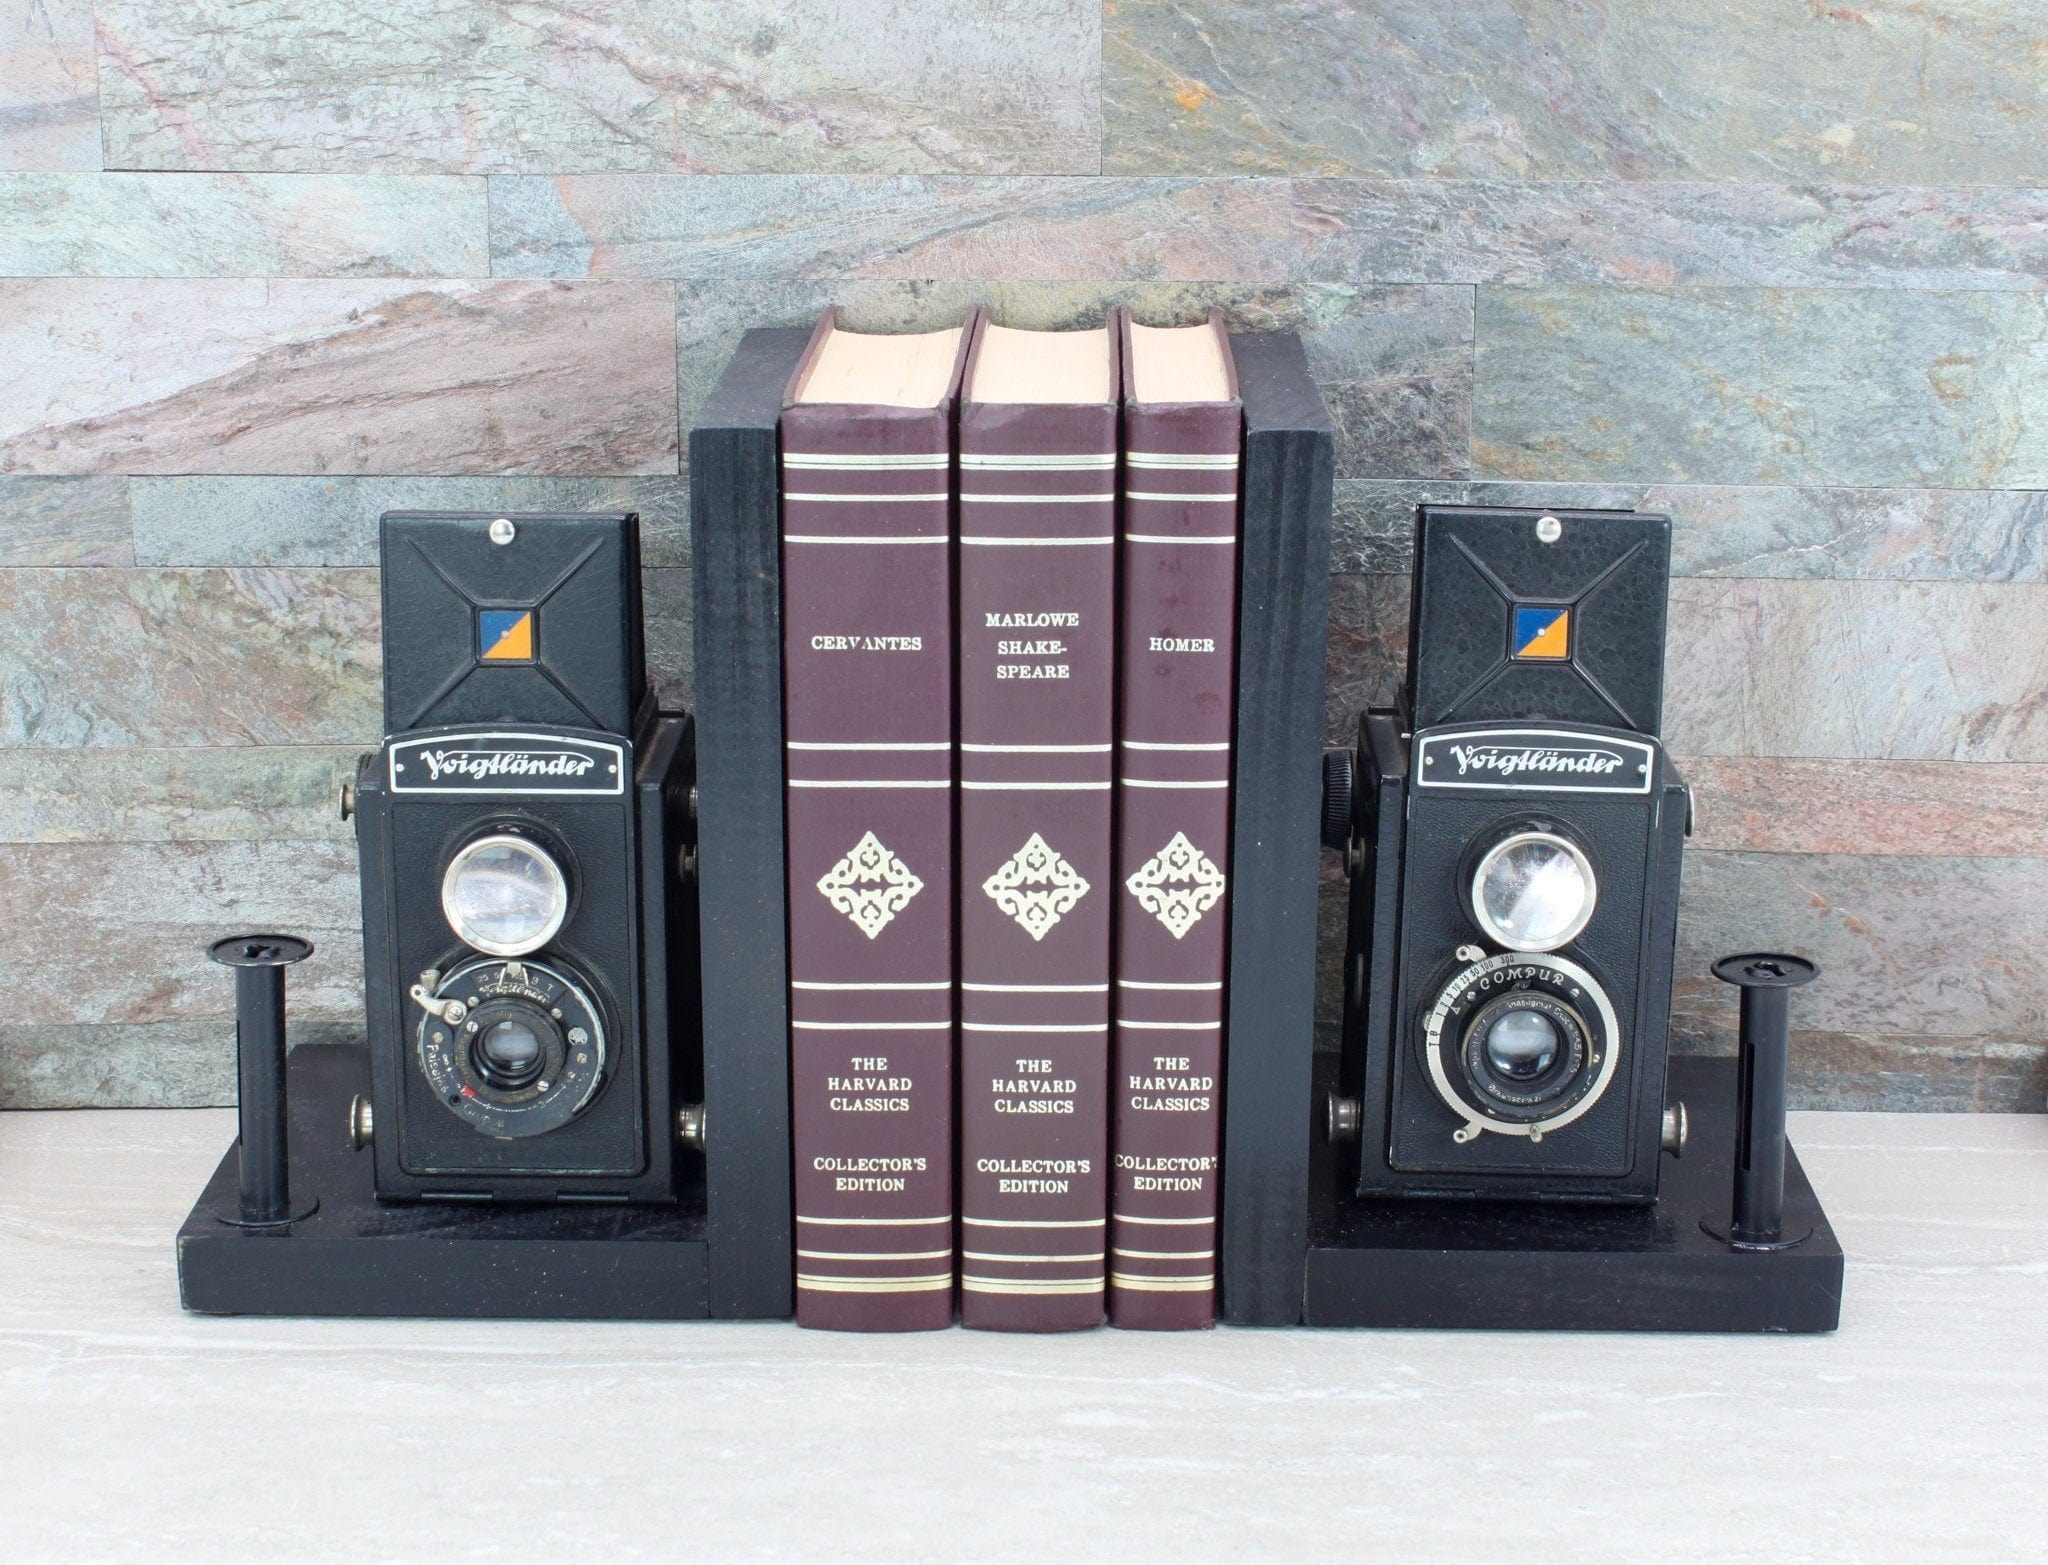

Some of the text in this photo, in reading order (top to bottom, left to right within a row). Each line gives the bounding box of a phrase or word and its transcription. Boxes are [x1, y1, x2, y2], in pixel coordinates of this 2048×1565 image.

[986, 613, 1079, 626] MARLOWE
[812, 636, 921, 650] CERVANTES
[998, 641, 1067, 654] SHAKE-
[1150, 638, 1214, 652] HOMER
[997, 665, 1069, 678] SPEARE
[420, 750, 594, 780] Voigtländer
[1450, 745, 1623, 775] Voigtländer
[1481, 961, 1494, 970] 100
[1480, 966, 1564, 990] COMPUR
[852, 1058, 887, 1070] THE
[1016, 1060, 1051, 1072] THE
[1154, 1057, 1189, 1070] THE
[828, 1078, 912, 1090] HARVARD
[993, 1079, 1076, 1092] HARVARD
[1130, 1076, 1212, 1090] HARVARD
[830, 1098, 909, 1111] CLASSICS
[995, 1100, 1073, 1113] CLASSICS
[1132, 1097, 1209, 1111] CLASSICS
[814, 1158, 926, 1171] COLLECTOR'S
[977, 1159, 1090, 1173] COLLECTOR'S
[837, 1178, 904, 1191] EDITION
[1000, 1180, 1068, 1193] EDITION
[1134, 1177, 1202, 1190] EDITION
